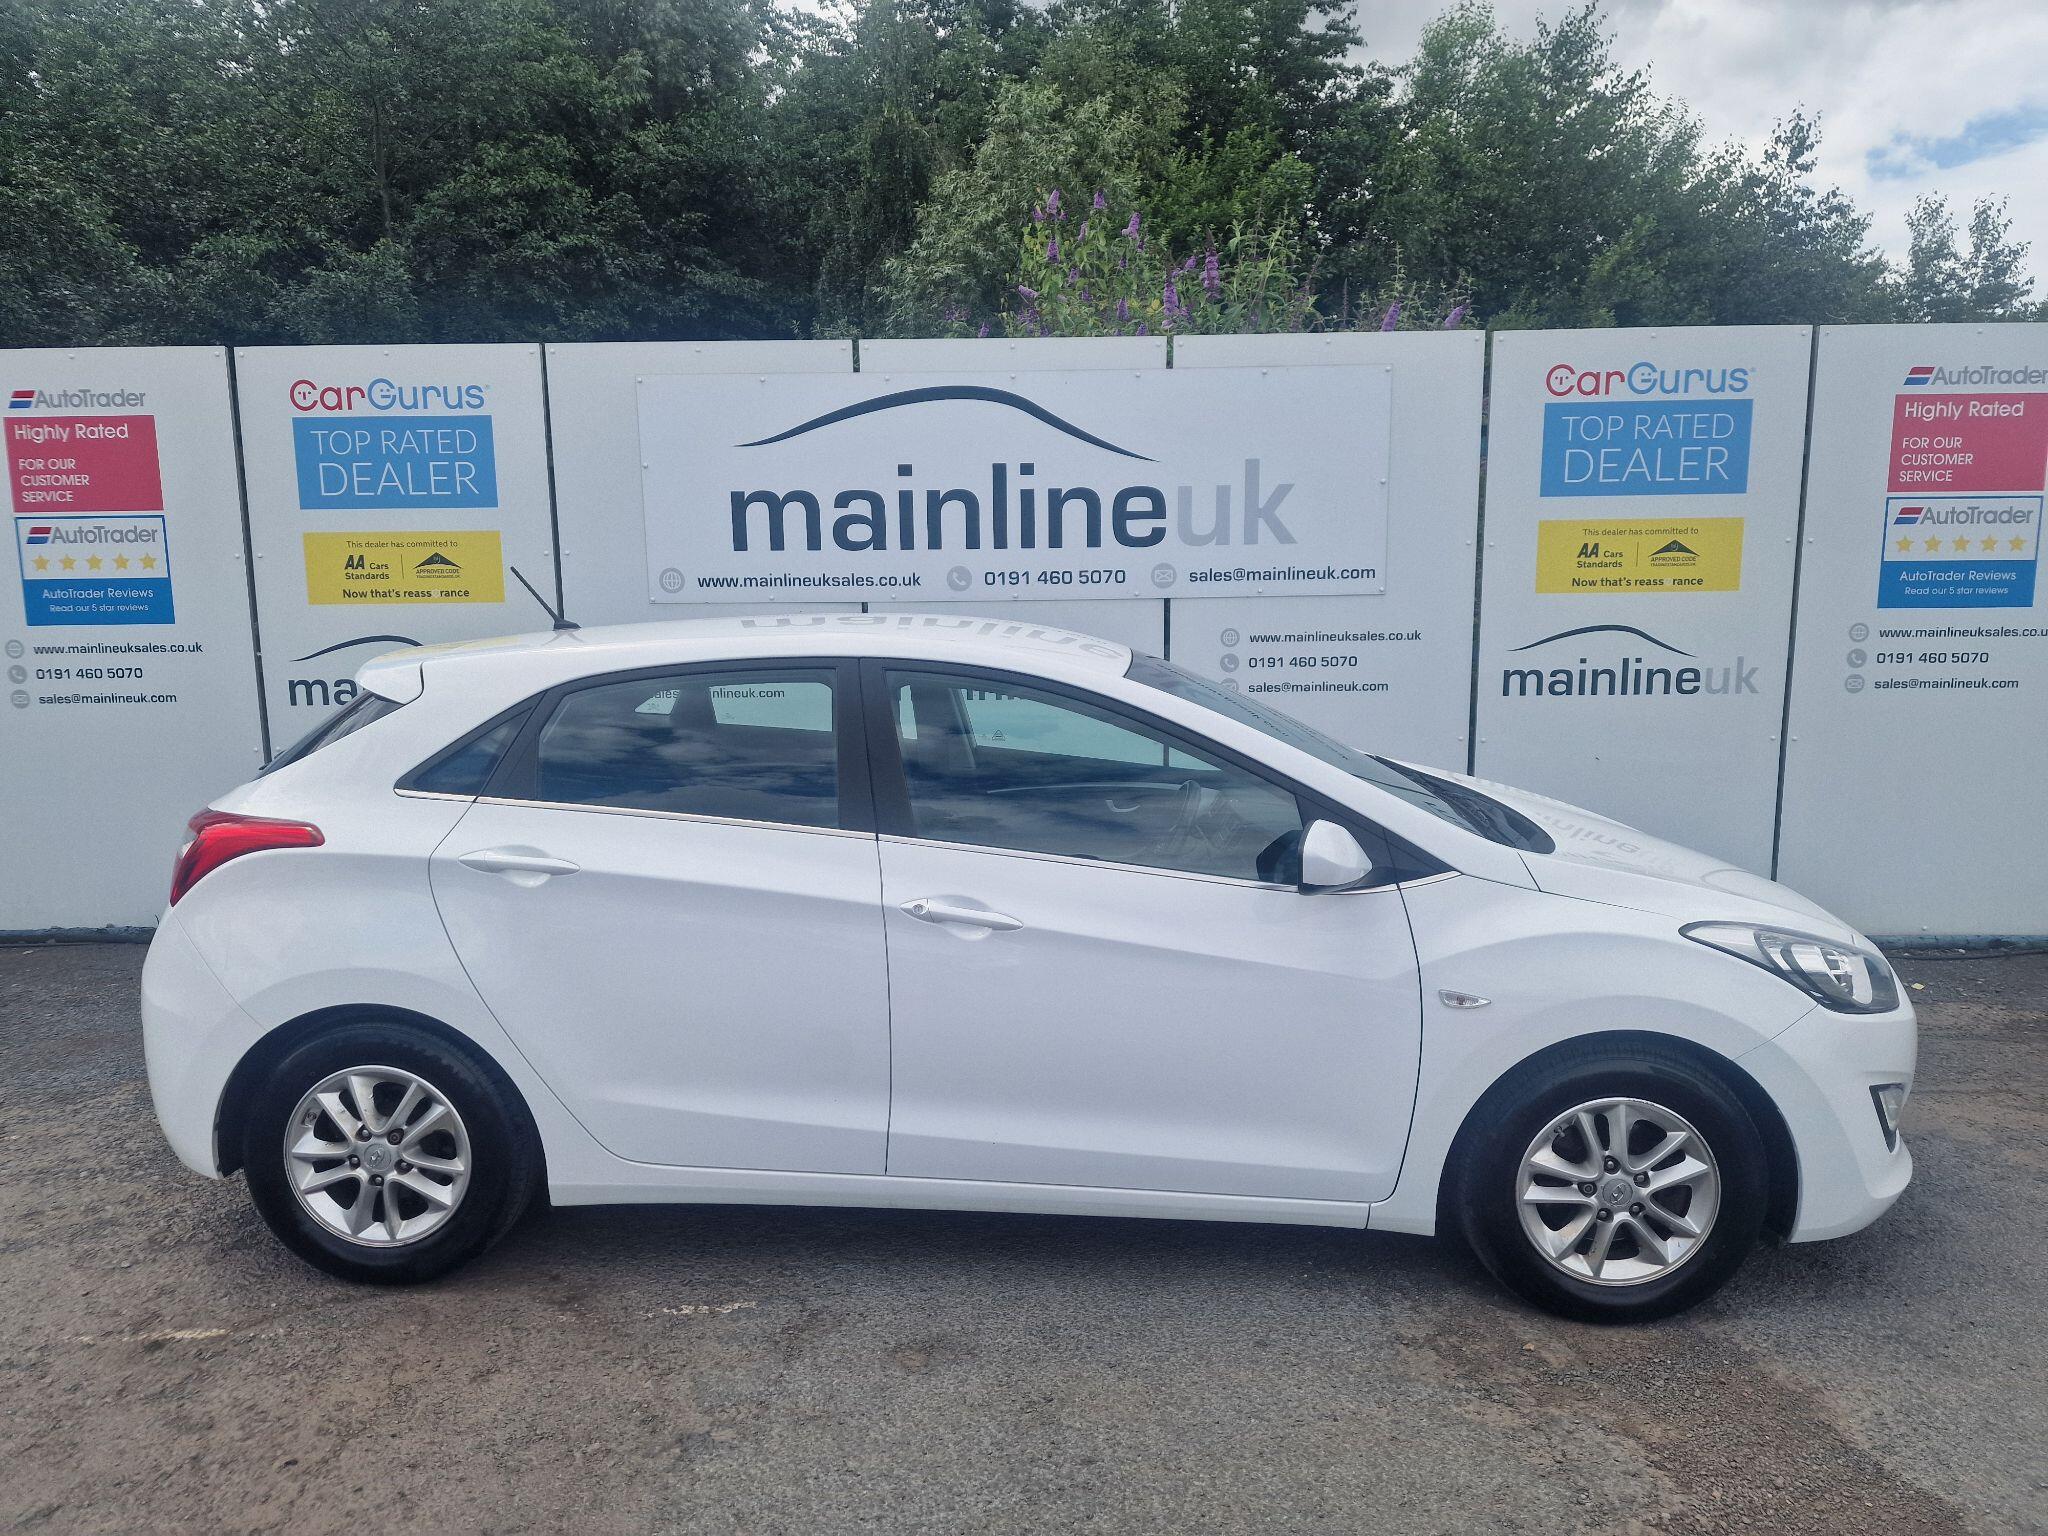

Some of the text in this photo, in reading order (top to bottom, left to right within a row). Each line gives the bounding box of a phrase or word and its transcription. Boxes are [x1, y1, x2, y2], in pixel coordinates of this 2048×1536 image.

[1545, 362, 1749, 397] CarGurus
[1931, 365, 2048, 385] AutoTrader
[34, 388, 146, 409] AutoTrader
[289, 378, 485, 411] CarGurus
[1904, 400, 2024, 422] Highly Rated
[13, 423, 129, 444] Highly Rated
[1562, 413, 1734, 441] TOP RATED
[310, 429, 477, 455] TOP RATED
[1902, 436, 1963, 449] FOR OUR
[18, 458, 76, 471] FOR OUR
[1563, 446, 1729, 483] DEALER
[1901, 453, 1974, 466] CUSTOMER
[20, 474, 90, 487] CUSTOMER
[318, 461, 480, 496] DEALER
[1898, 470, 1953, 483] SERVICE
[21, 490, 75, 504] SERVICE
[730, 458, 1298, 552] mainlineuk
[1920, 505, 2034, 526] AutoTrader
[51, 525, 158, 545] AutoTrader
[1583, 527, 1699, 536] This dealer has committed to
[390, 540, 405, 548] has
[406, 540, 448, 548] committed
[449, 540, 458, 548] to
[1576, 542, 1624, 559] AA Cars
[344, 554, 389, 570] AA Cars
[1576, 560, 1623, 568] Standards
[345, 572, 390, 580] Standards
[697, 572, 921, 588] www.mainlineuksales.co.uk
[984, 569, 1126, 586] 0191 460 5070
[1188, 565, 1376, 583] sales@mainlineuk.com
[1899, 570, 2017, 582] AutoTrader Reviews
[1571, 577, 1598, 587] Now
[1600, 577, 1632, 587] that's
[42, 588, 154, 600] AutoTrader Reviews
[342, 589, 368, 599] Now
[370, 588, 401, 598] that's
[1904, 586, 1930, 595] Read
[1949, 586, 1955, 595] 5
[1956, 586, 1974, 595] star
[1975, 586, 2009, 595] reviews
[49, 603, 74, 612] Read
[91, 603, 98, 612] 5
[98, 603, 116, 612] star
[116, 603, 150, 612] reviews
[1249, 630, 1422, 643] www.mainlineuksales.co.uk
[1878, 626, 2048, 638] www.mainlineuksales.co.u
[33, 642, 204, 655] www.mainlineuksales.co.uk
[1248, 655, 1358, 668] 0191 460 5070
[1876, 651, 1989, 664] 0191 460 5070
[35, 667, 144, 680] 0191 460 5070
[1501, 656, 1760, 697] mainlineuk
[1248, 681, 1389, 694] sales@mainlineuk.com
[1873, 677, 2019, 690] sales@mainlineuk.com
[38, 693, 177, 705] sales@mainlineuk.com
